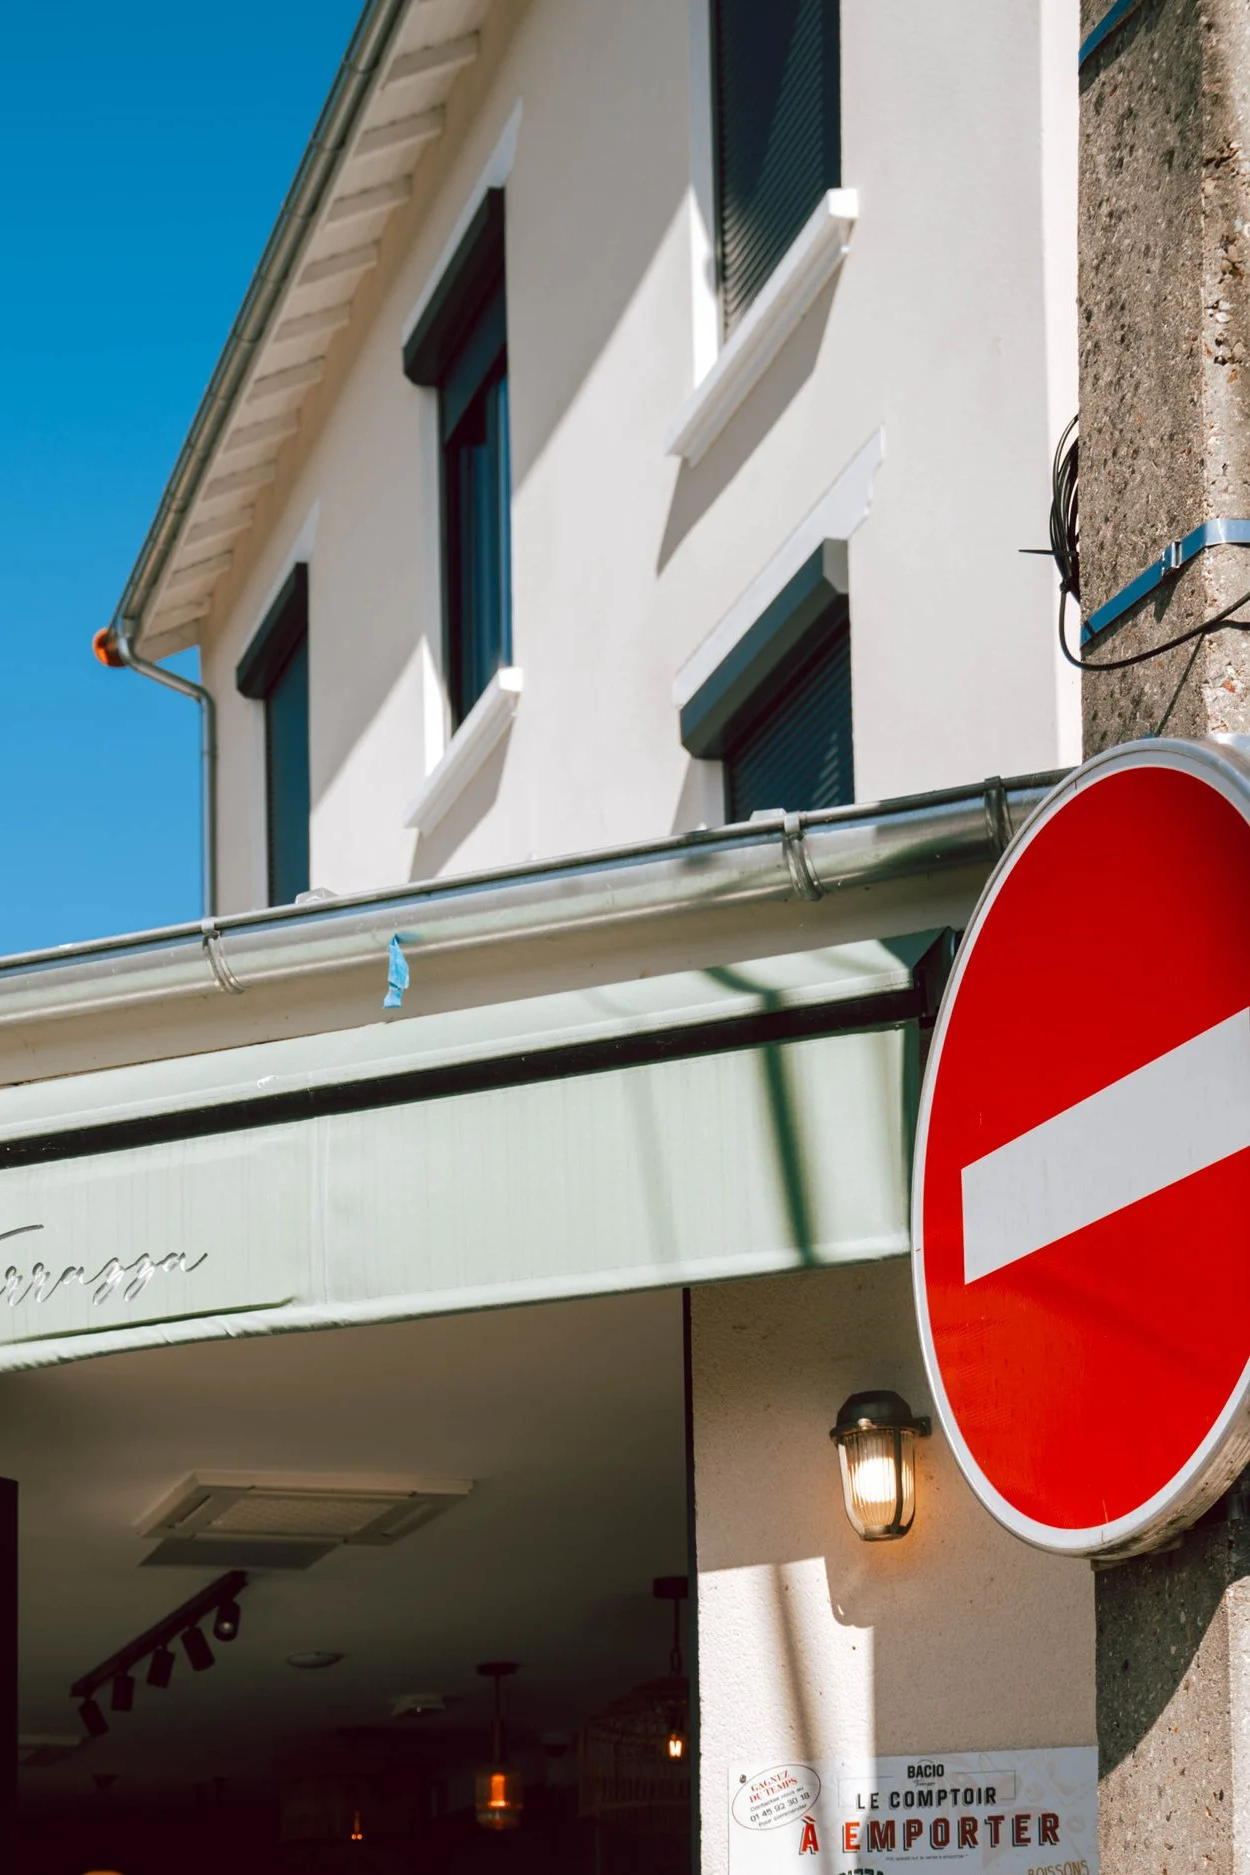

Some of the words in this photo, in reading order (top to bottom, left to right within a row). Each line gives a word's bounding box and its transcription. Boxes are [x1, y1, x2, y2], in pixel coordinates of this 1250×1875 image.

[907, 1764, 944, 1779] BACIO
[858, 1792, 880, 1809] LE
[890, 1787, 996, 1810] COMPTOIR
[798, 1815, 819, 1855] À
[842, 1812, 1060, 1854] EMPORTER
